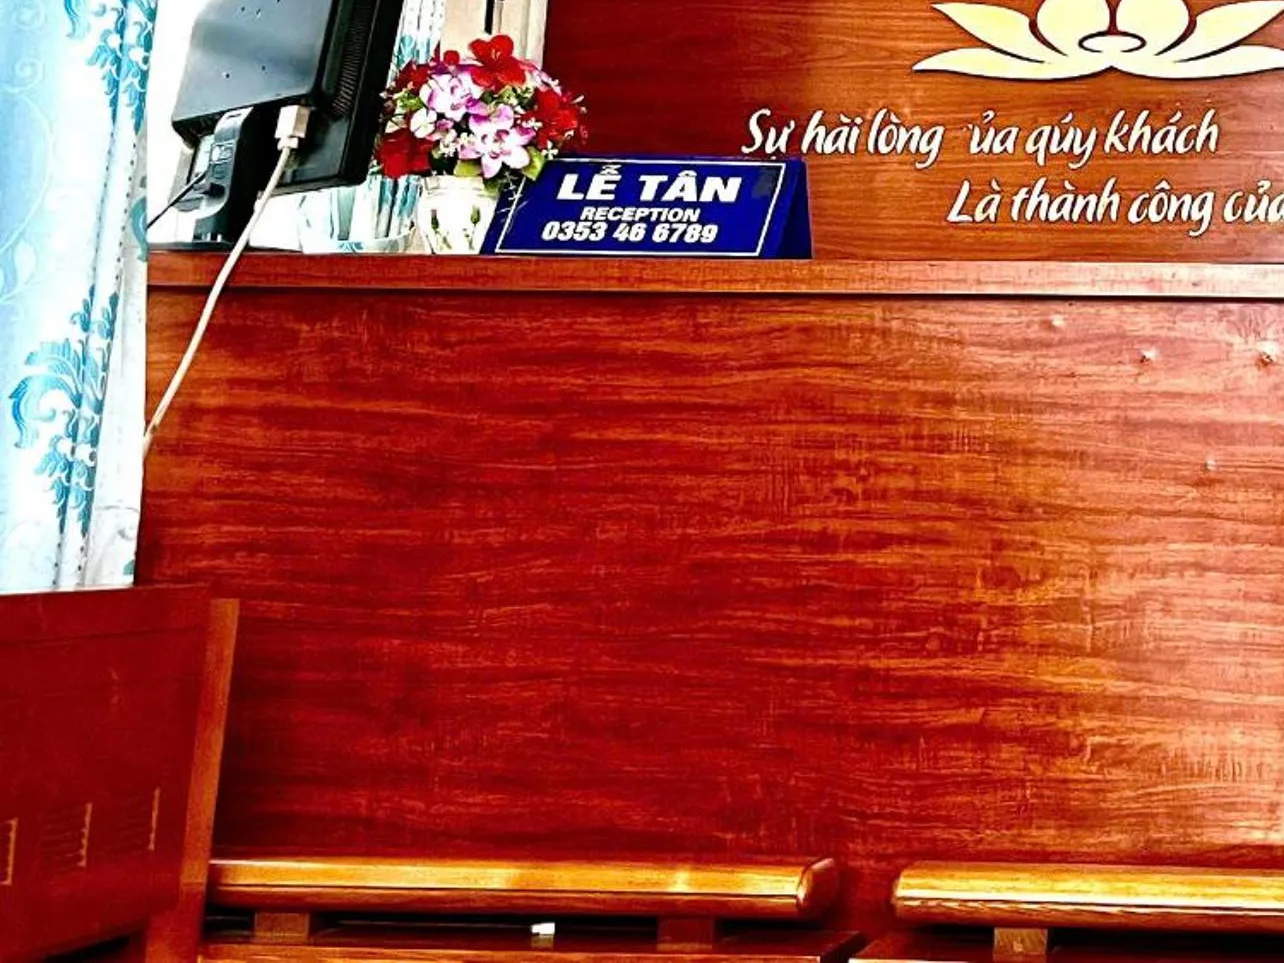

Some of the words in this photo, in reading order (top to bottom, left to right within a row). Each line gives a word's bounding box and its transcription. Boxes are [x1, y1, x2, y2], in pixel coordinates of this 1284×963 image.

[741, 107, 794, 161] Sự
[801, 109, 859, 155] hài
[868, 108, 945, 170] lòng
[1103, 109, 1219, 155] khách
[638, 169, 743, 203] TÂN
[580, 206, 701, 223] RECEPTION
[947, 179, 1000, 224] Là
[1010, 176, 1120, 223] thành
[1128, 180, 1213, 237] công
[541, 221, 607, 242] 0353
[613, 222, 646, 242] 46
[652, 223, 718, 244] 6789
